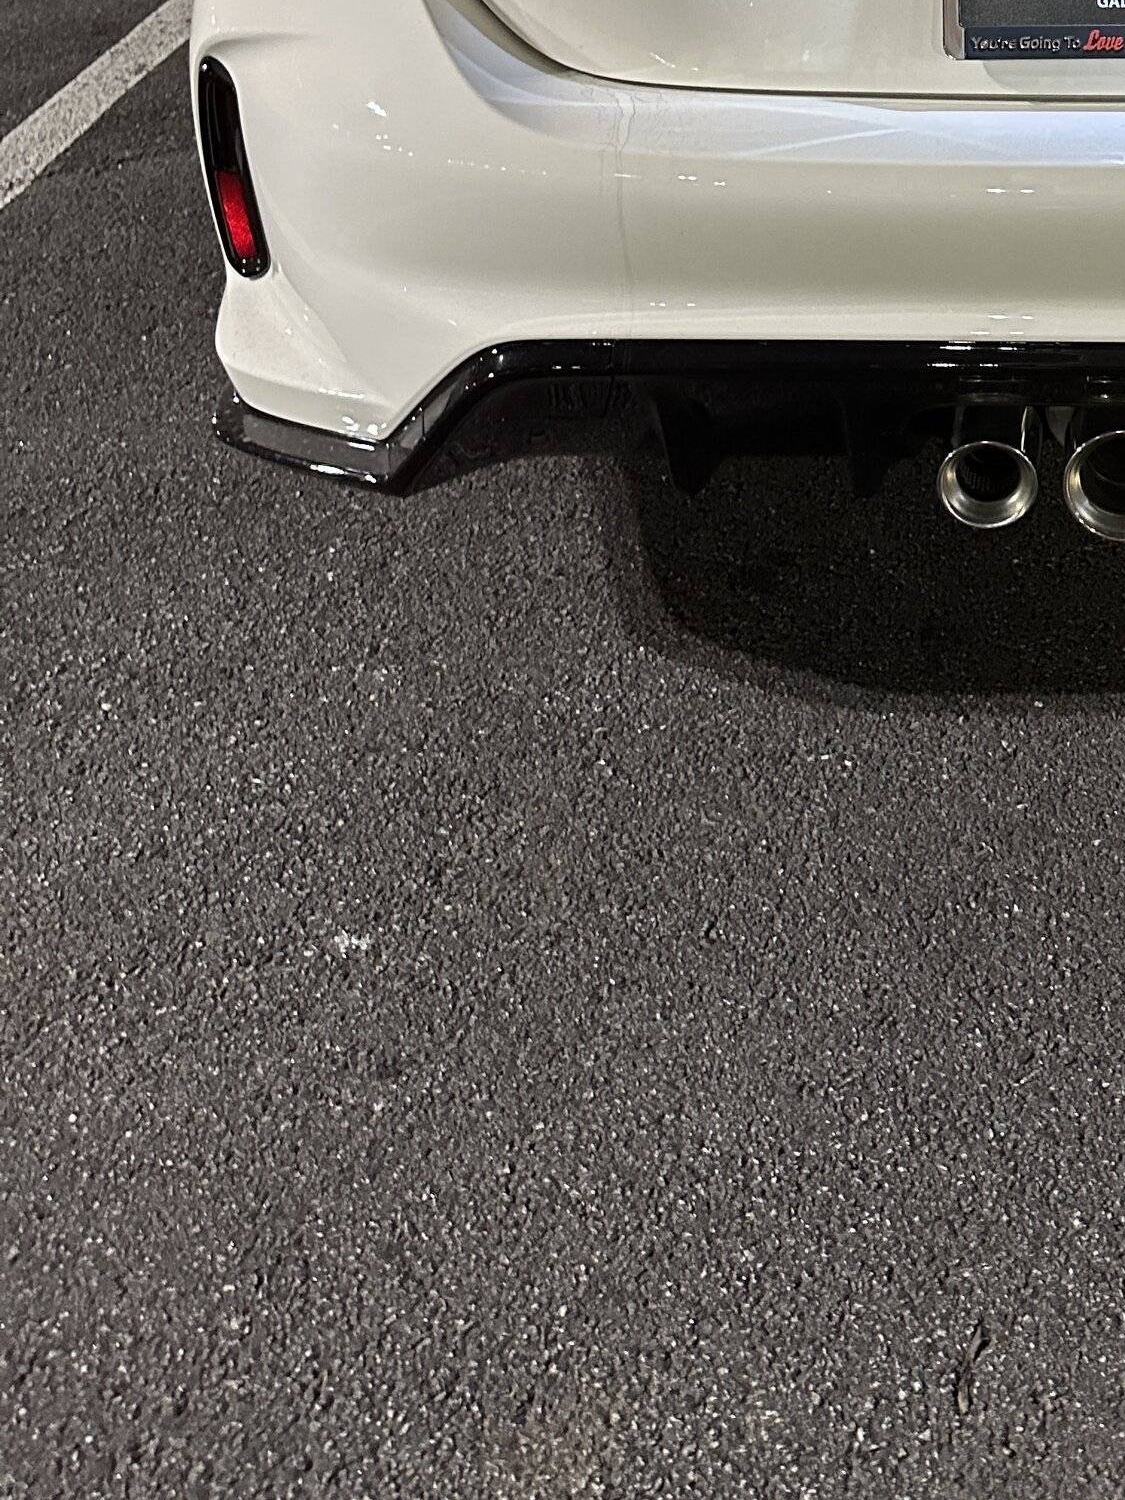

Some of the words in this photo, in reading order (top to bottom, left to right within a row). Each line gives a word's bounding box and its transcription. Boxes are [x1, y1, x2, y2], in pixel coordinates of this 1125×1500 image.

[971, 35, 1017, 50] You're
[1019, 35, 1061, 52] Going
[1063, 35, 1081, 49] To
[1082, 28, 1125, 51] Love
